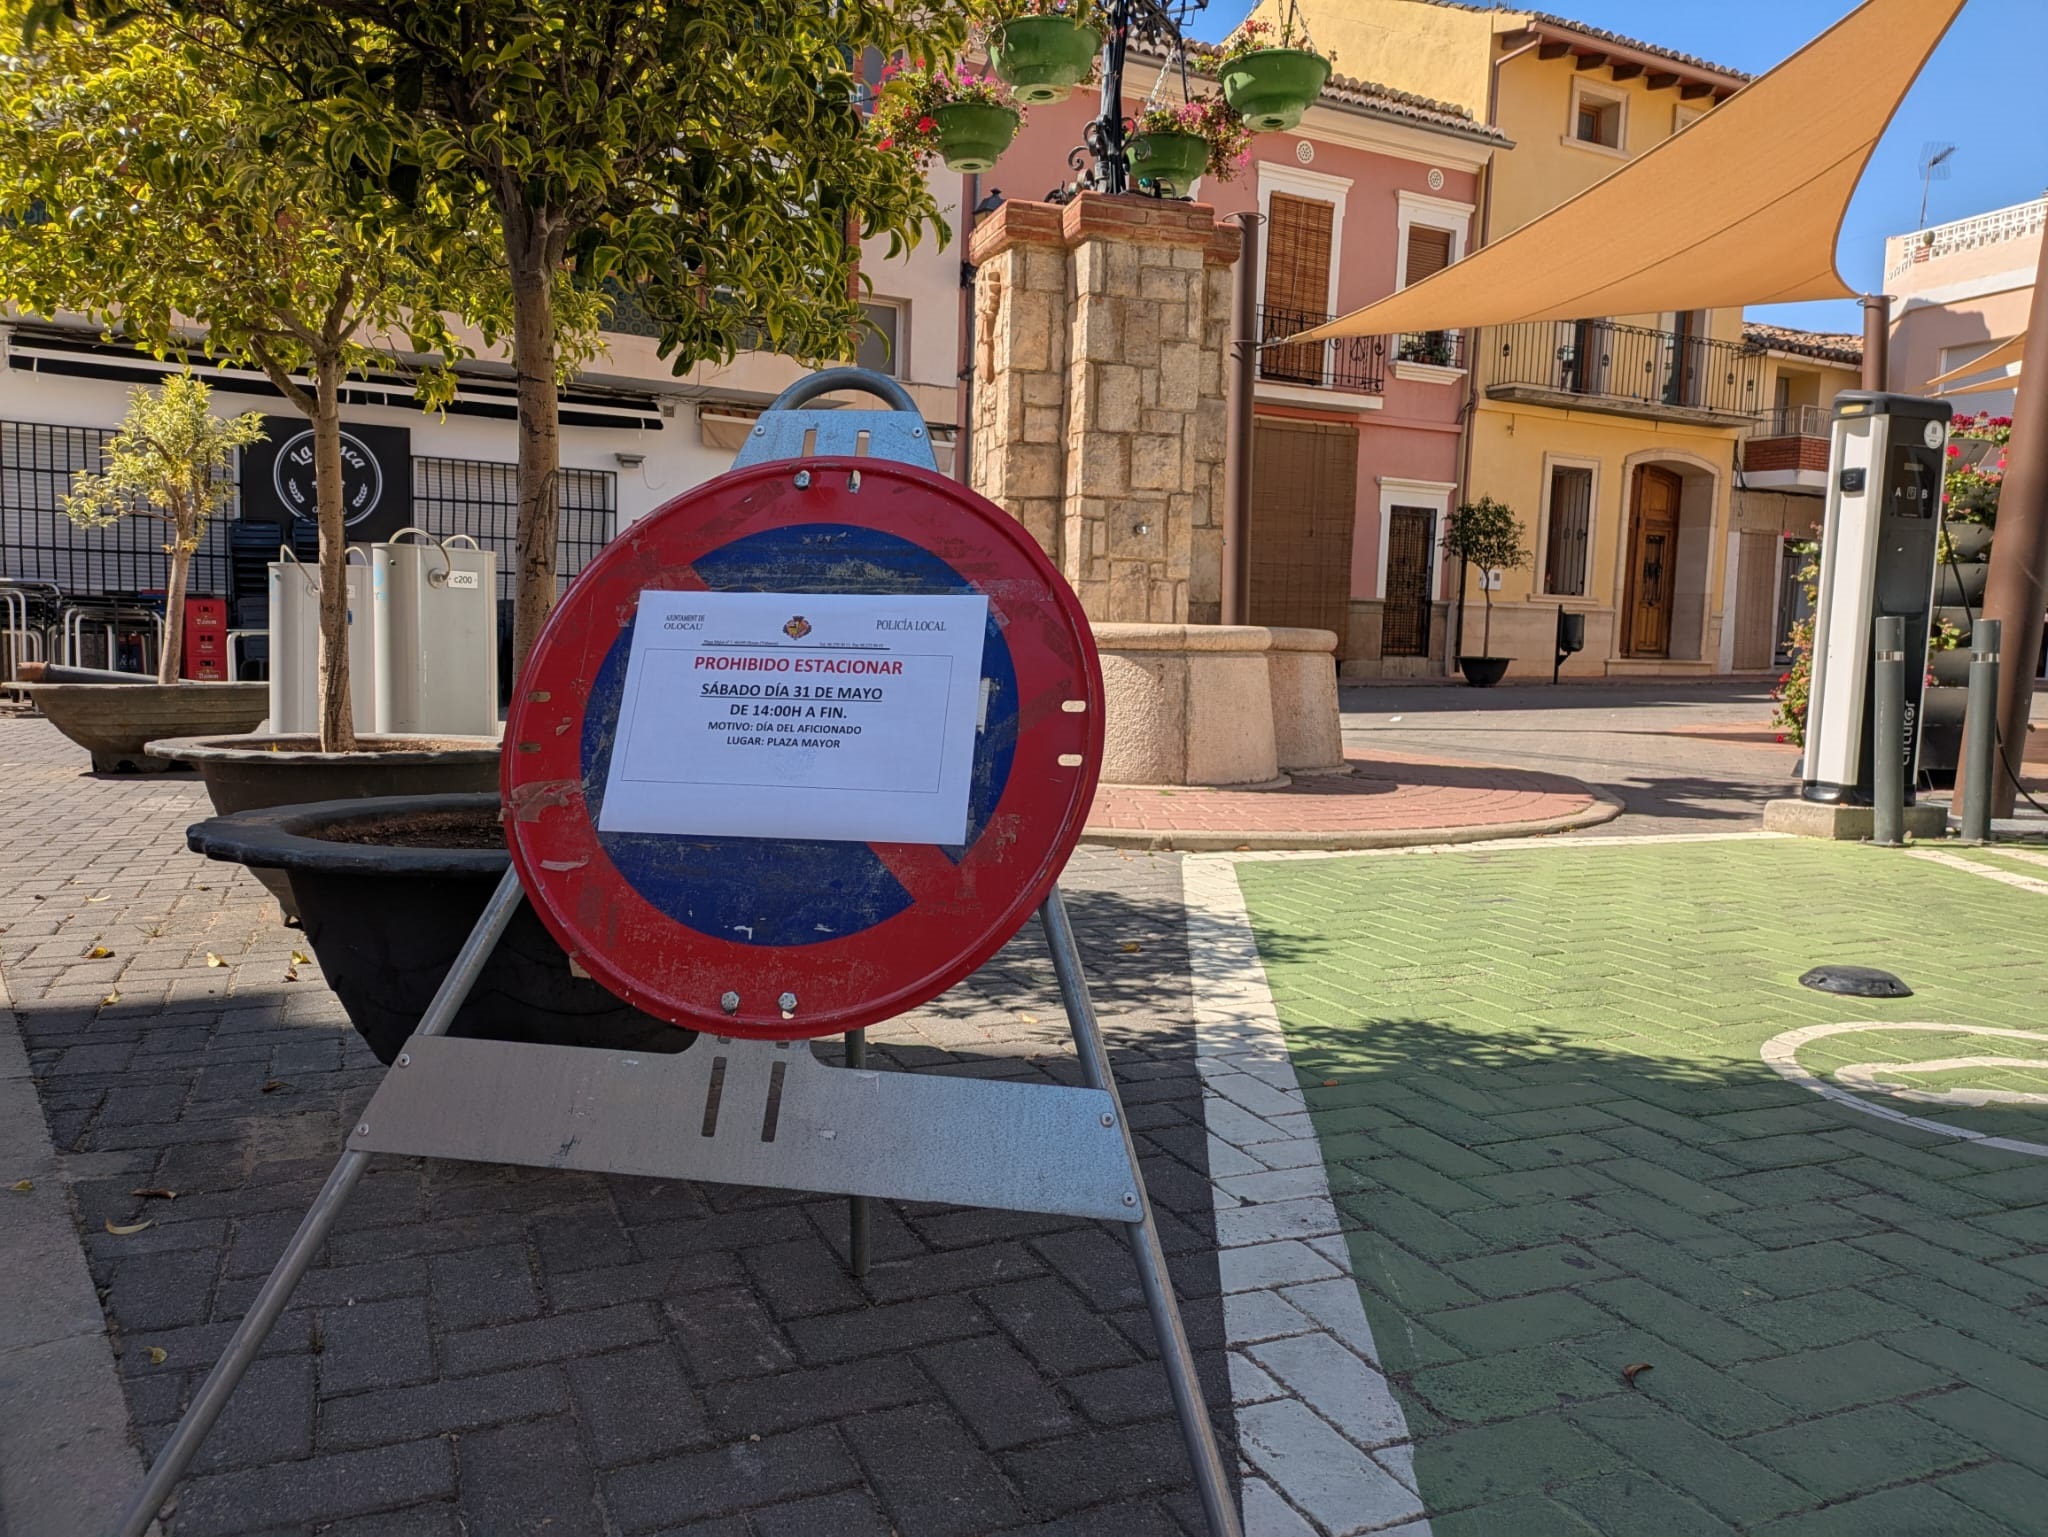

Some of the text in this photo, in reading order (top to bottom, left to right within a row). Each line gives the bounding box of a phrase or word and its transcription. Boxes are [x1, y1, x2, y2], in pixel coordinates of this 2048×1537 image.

[290, 445, 313, 466] La
[1895, 487, 1902, 497] A
[1921, 489, 1928, 499] B
[454, 575, 473, 584] c200
[665, 614, 697, 622] AJUNTAMENT
[664, 622, 704, 631] OLOCAU
[876, 618, 947, 632] POLICÍA LOCAL
[694, 656, 903, 675] PROHIBIDO ESTACIONAR
[701, 681, 883, 700] SÁBADO DÍA 31 DE MAYO
[730, 704, 847, 719] DE 14:00H A FIN.
[708, 721, 862, 735] MOTIVO: DÍA DEL AFICIONADO
[727, 736, 840, 748] LUGAR: PLAZA MAYOR
